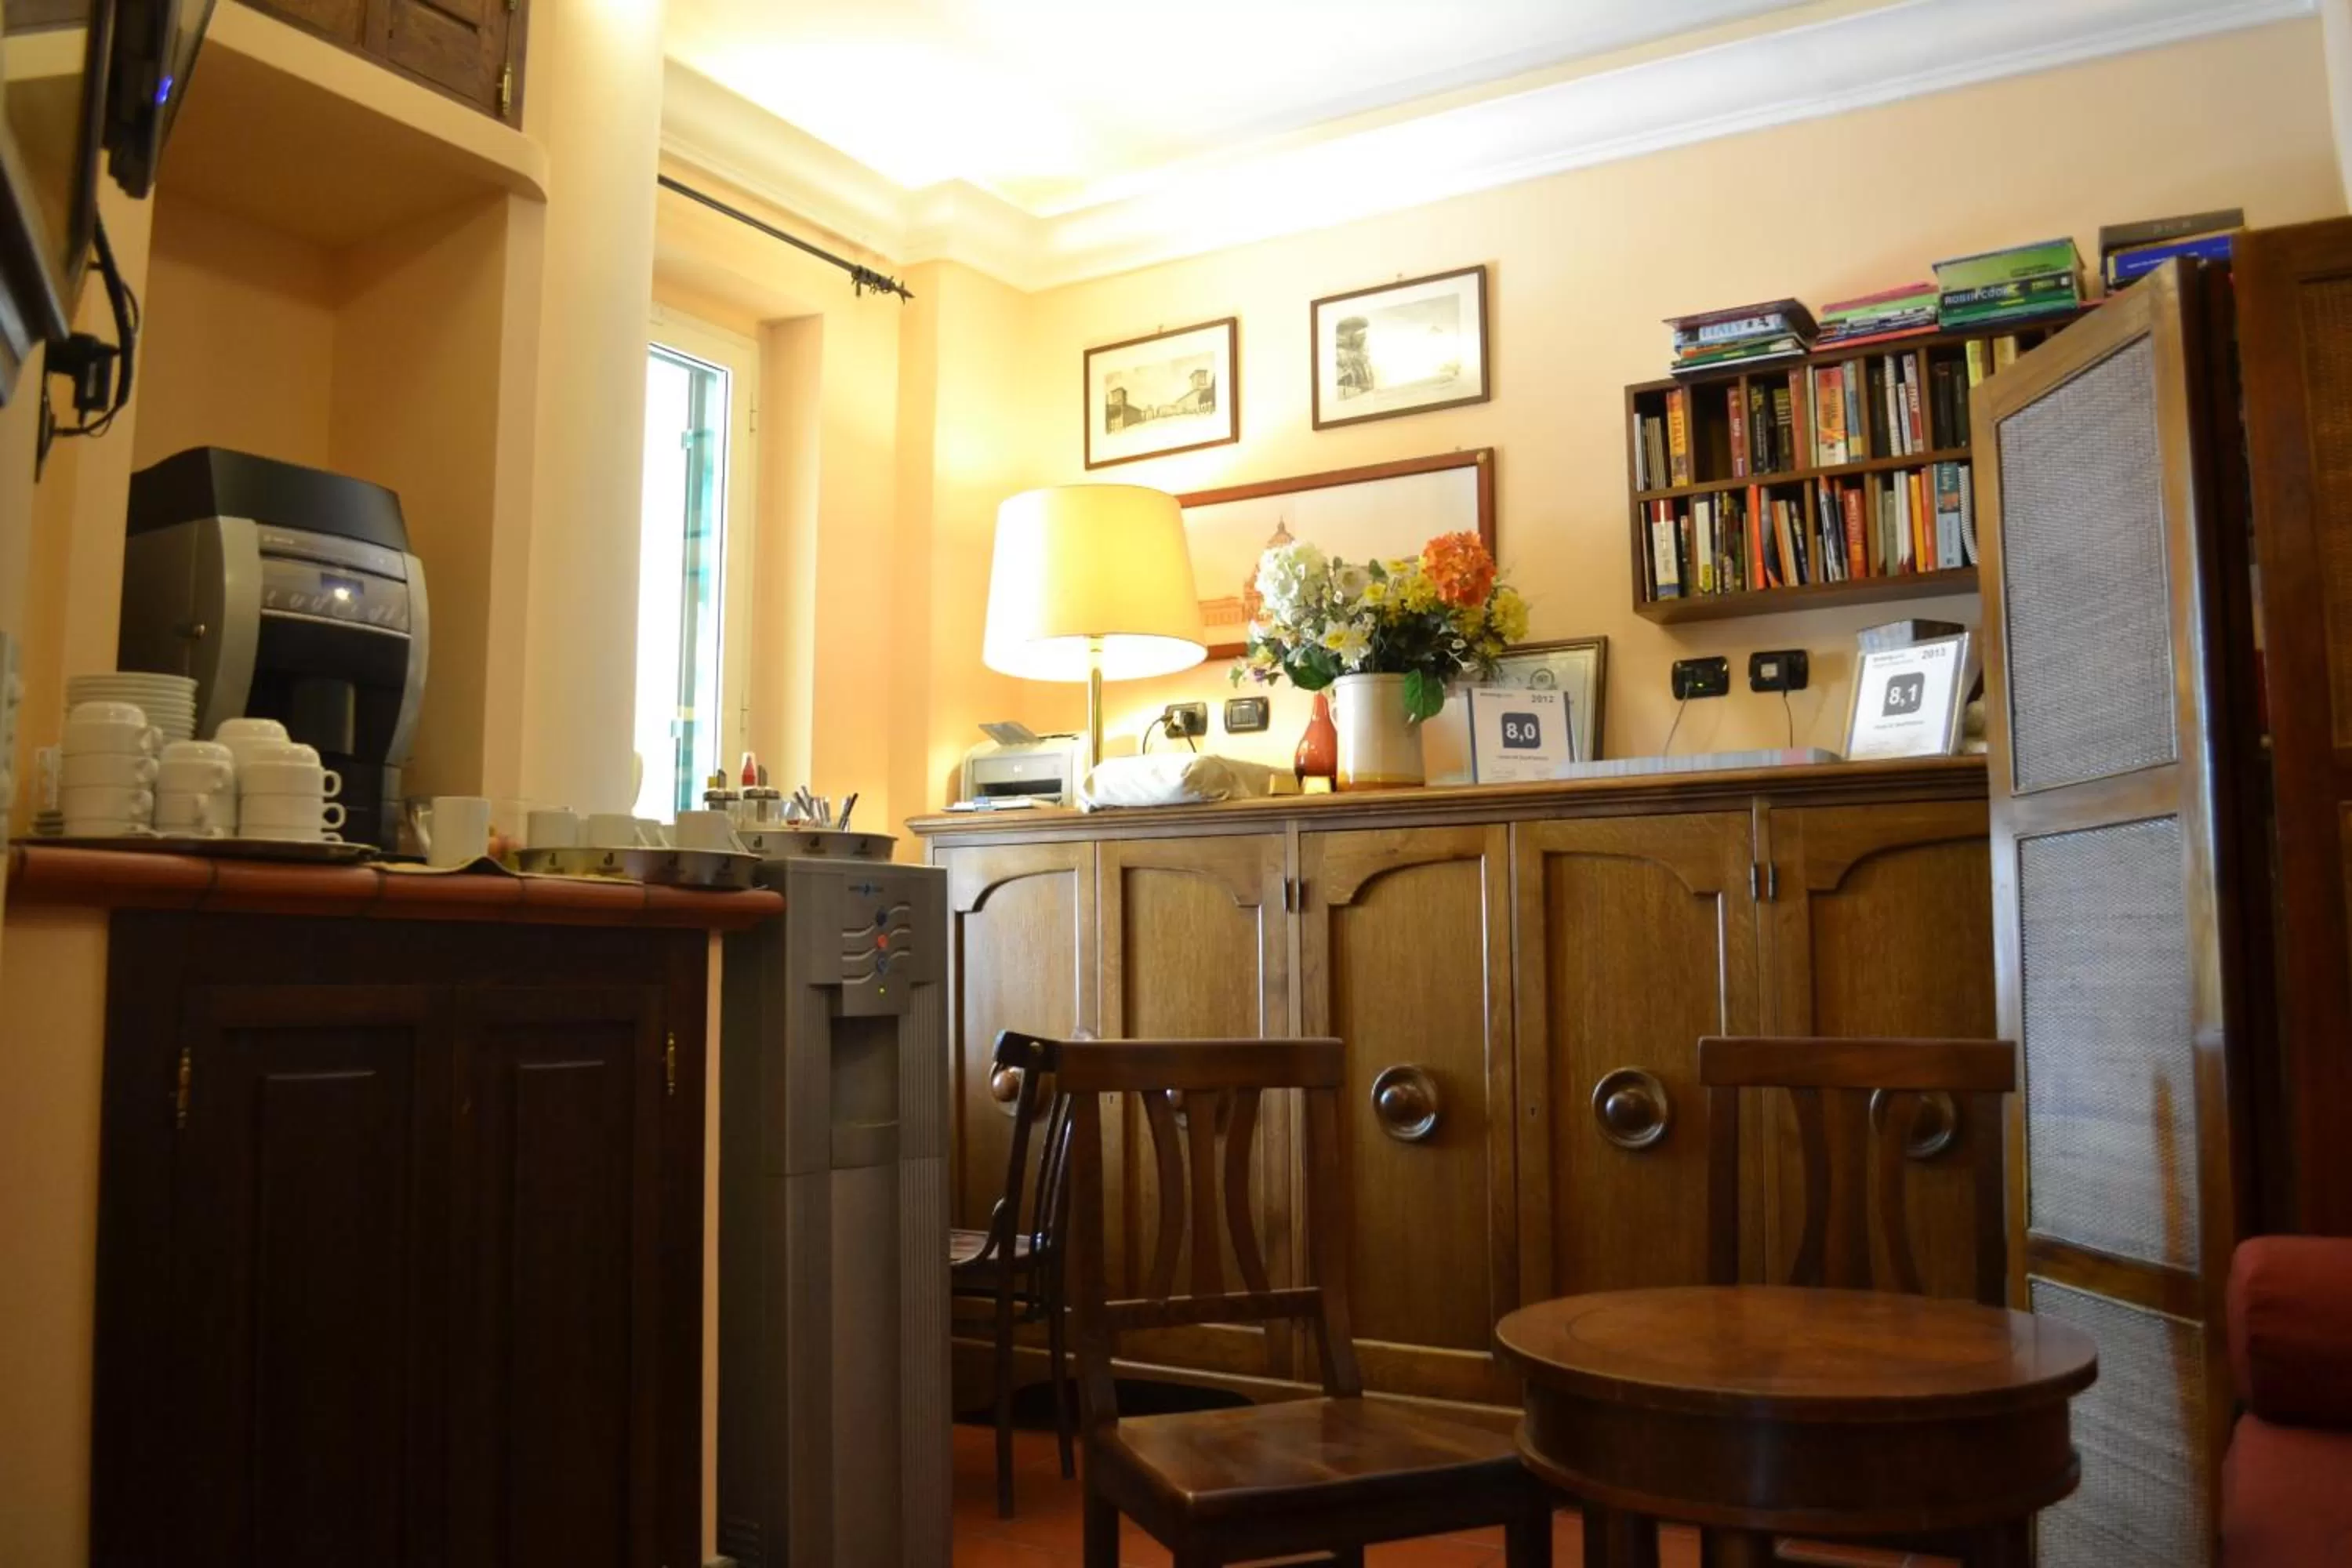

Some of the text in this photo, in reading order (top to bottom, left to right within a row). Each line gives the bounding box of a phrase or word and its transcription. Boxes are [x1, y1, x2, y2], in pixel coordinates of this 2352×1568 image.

[1944, 288, 1979, 306] ROBIN
[1922, 647, 1946, 660] 2013
[1531, 694, 1556, 703] 2012
[1889, 683, 1918, 707] 8,1
[1505, 721, 1537, 742] 8,0
